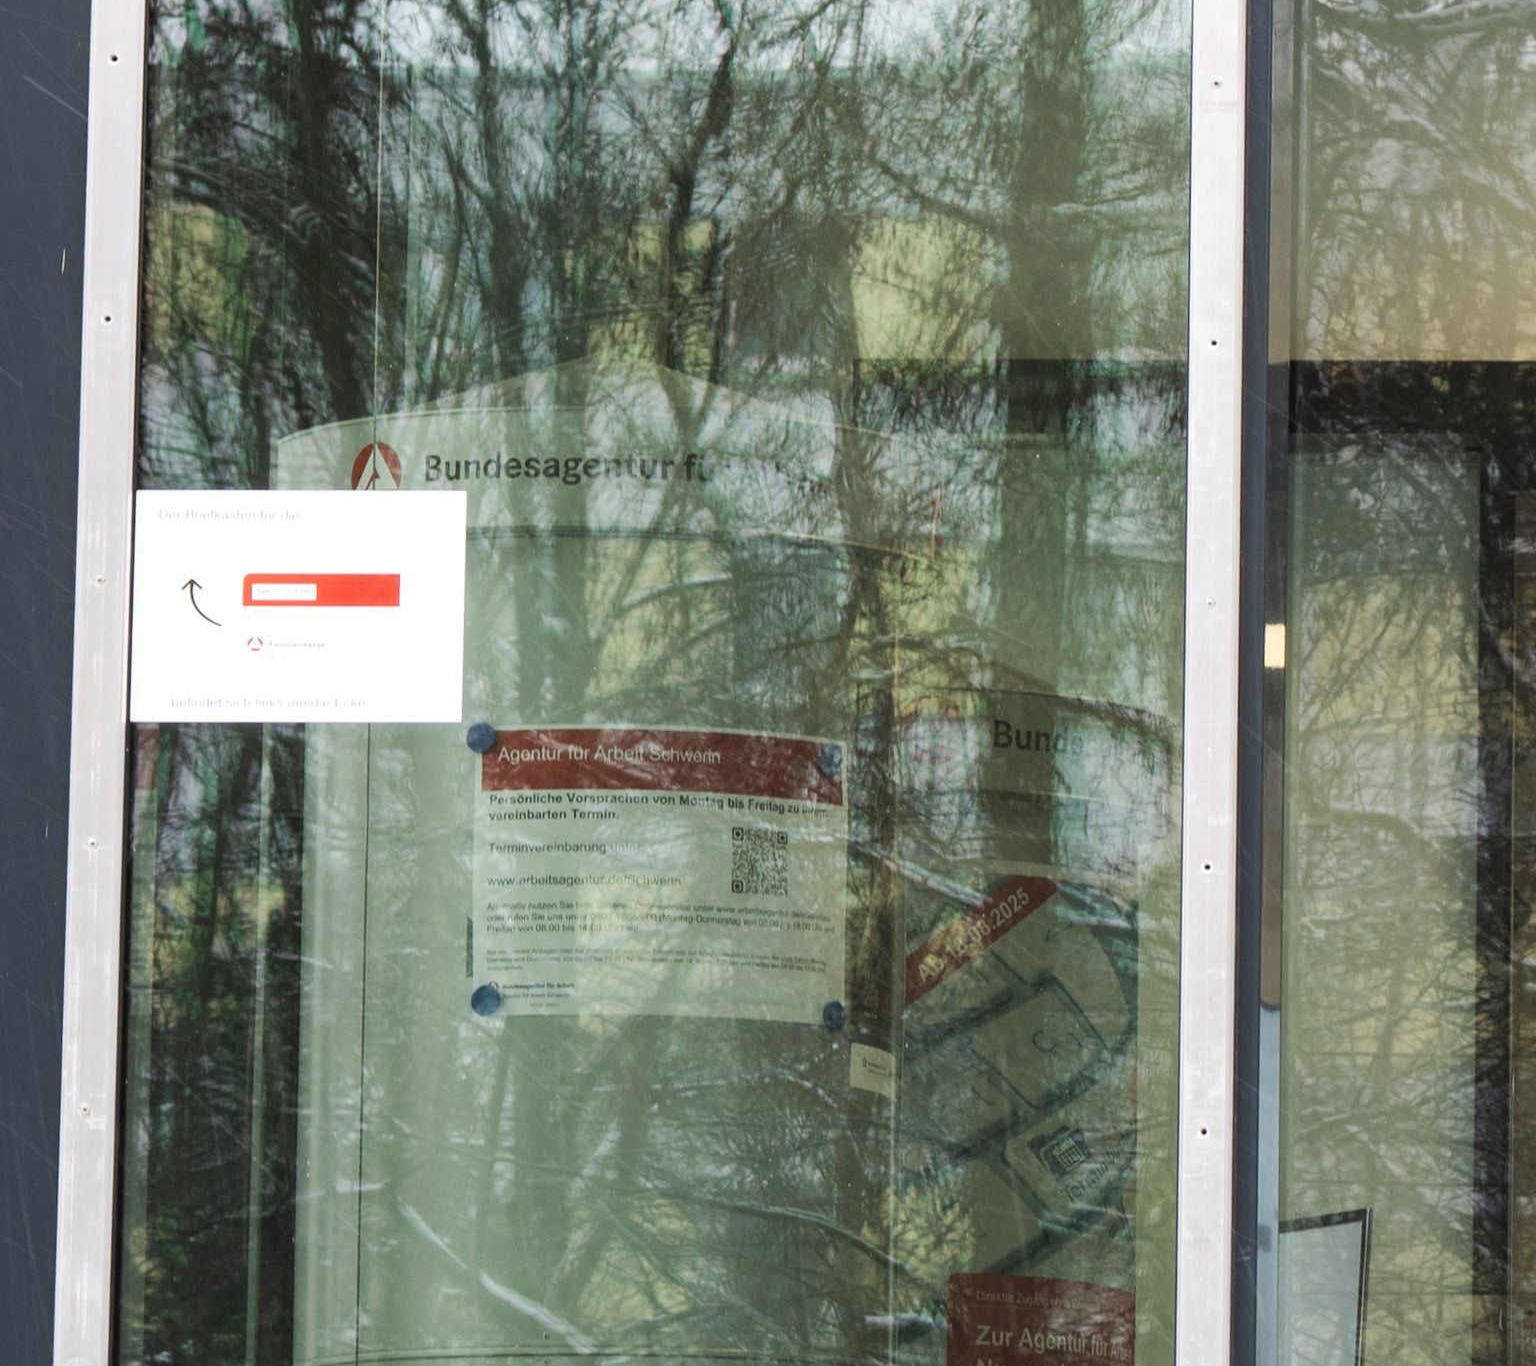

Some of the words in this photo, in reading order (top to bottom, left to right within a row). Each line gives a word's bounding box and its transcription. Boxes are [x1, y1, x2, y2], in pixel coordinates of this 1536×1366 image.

[424, 452, 673, 485] Bundesagentur
[498, 745, 563, 765] Agentur
[568, 745, 592, 762] für
[594, 745, 646, 762] Arbeit
[649, 745, 721, 764] Schwerin
[489, 793, 563, 805] Persönliche
[567, 793, 649, 807] Vorsprachen
[653, 795, 676, 806] von
[680, 795, 723, 810] Montag
[728, 797, 744, 809] bis
[748, 798, 785, 815] Freitag
[489, 809, 567, 821] vereinbarten
[571, 808, 620, 820] Termin.
[488, 842, 607, 856] Terminvereinbarung
[975, 1324, 1014, 1347] Zur
[1018, 1327, 1088, 1355] Agentur
